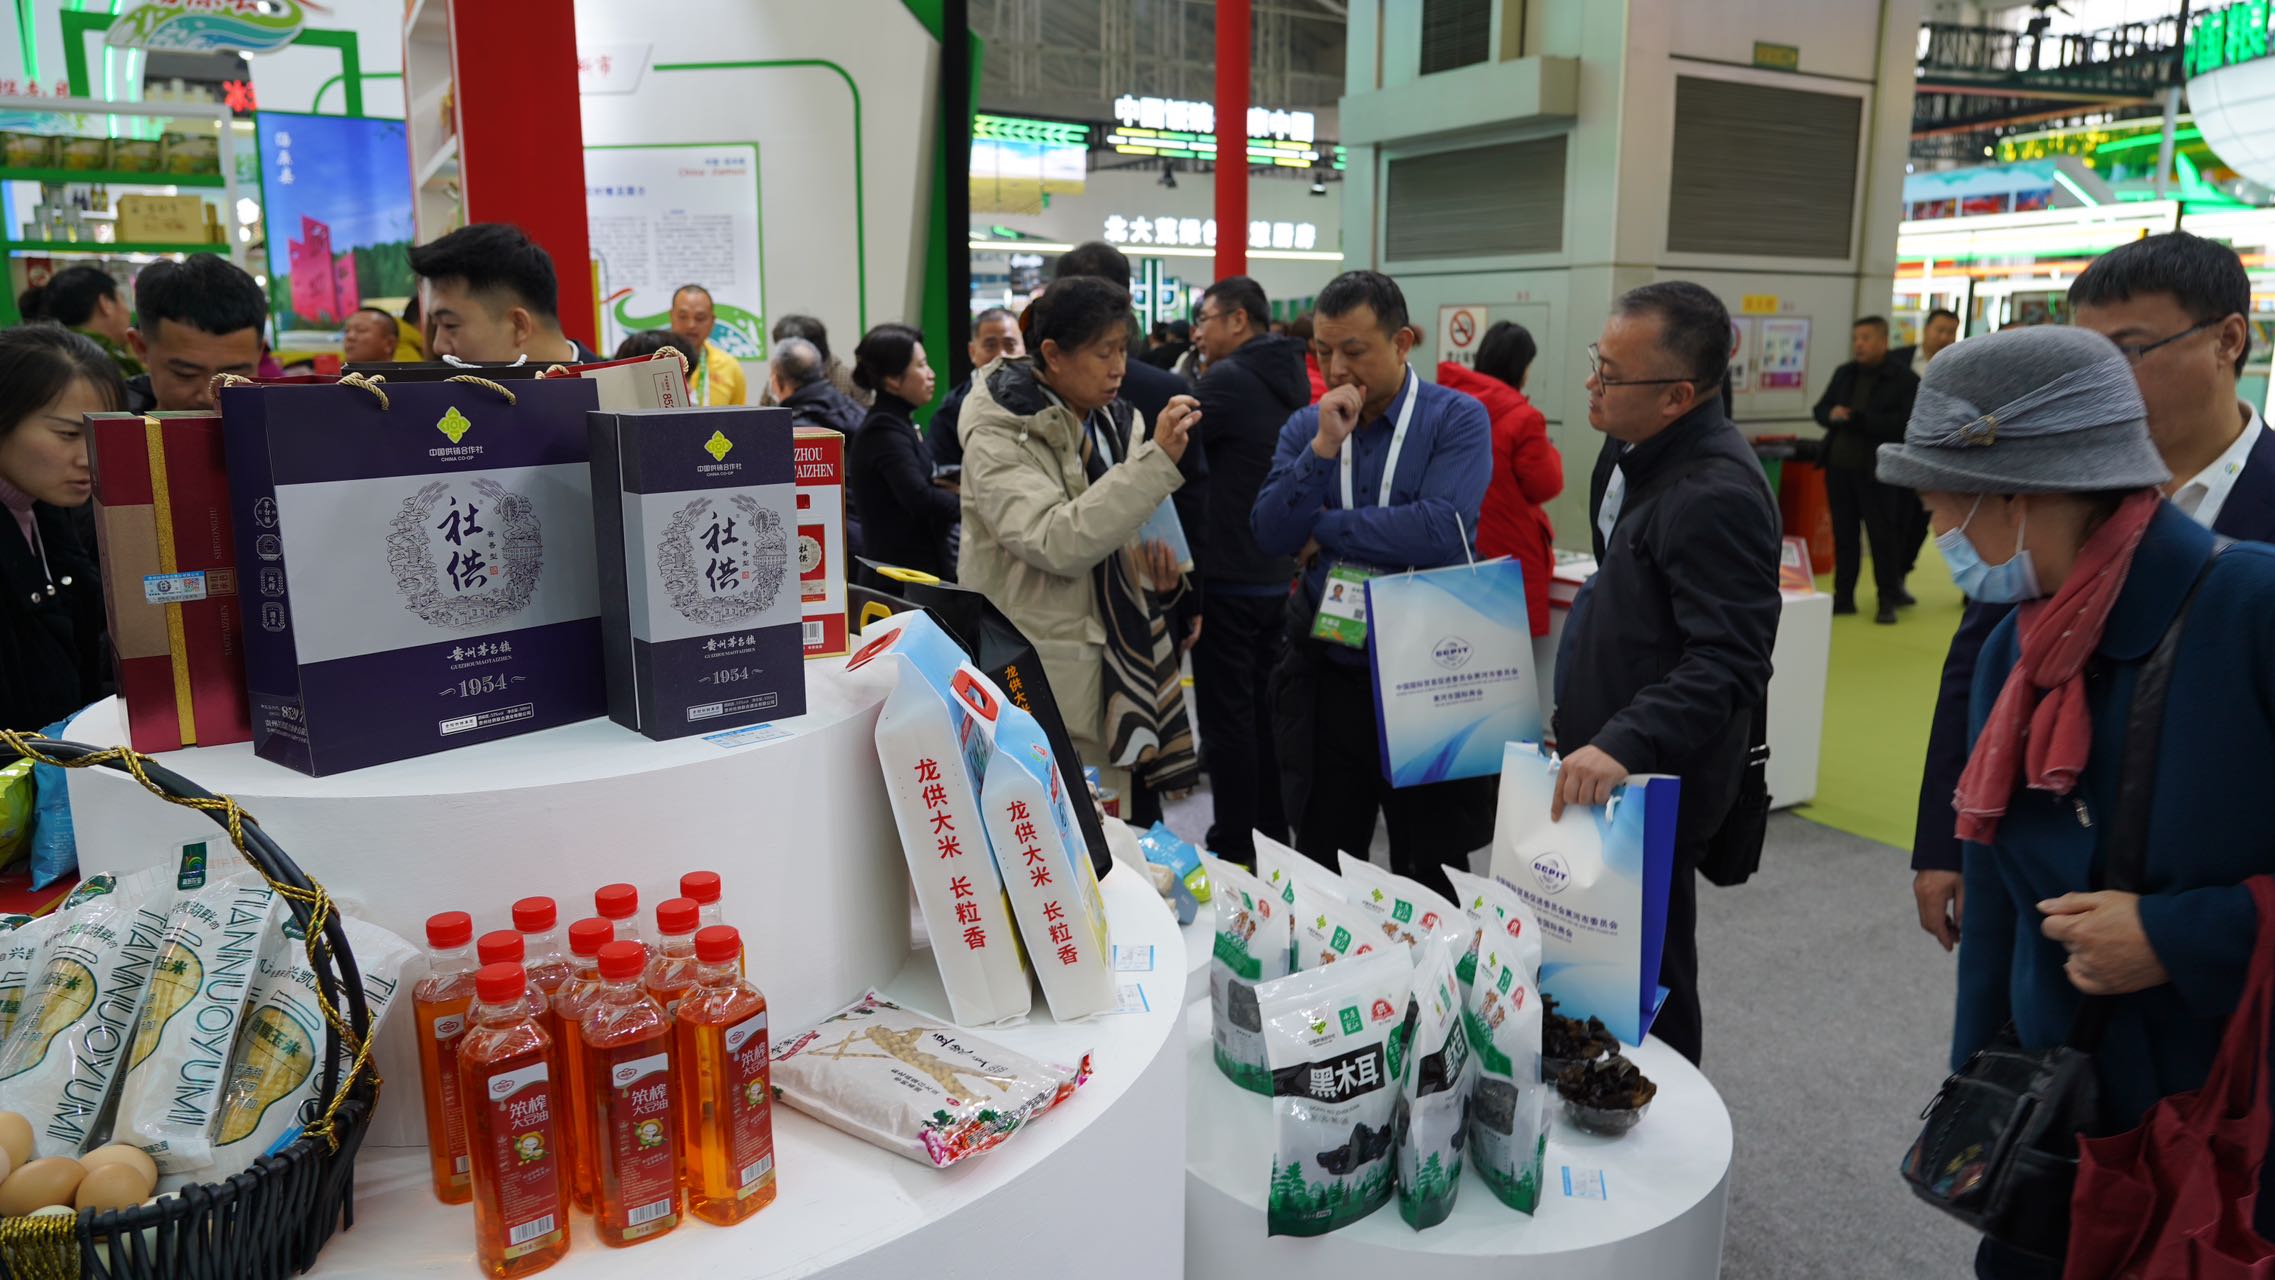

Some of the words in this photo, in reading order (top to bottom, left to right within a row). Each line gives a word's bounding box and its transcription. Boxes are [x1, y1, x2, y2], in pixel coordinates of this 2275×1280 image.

[429, 446, 484, 457] 中国供销合作社
[794, 447, 823, 462] ZHOU
[446, 640, 512, 661] 贵州茅台镇
[1435, 646, 1469, 657] CCPIT
[459, 673, 507, 697] 1954
[713, 667, 749, 685] 1954
[913, 757, 963, 860] 龙供大米
[949, 876, 988, 952] 长粒香
[1534, 862, 1567, 881] CCPIT
[1006, 800, 1054, 888] 龙供大米
[1042, 901, 1080, 967] 长粒香
[166, 886, 275, 1126] TIANNUOYUMI
[46, 908, 168, 1145] TIANNUOYUMI
[1309, 1051, 1380, 1098] 黑木耳
[632, 1083, 666, 1106] 笨榨
[509, 1094, 547, 1120] 笨榨
[633, 1098, 669, 1117] 大豆油
[511, 1110, 549, 1130] 大豆油
